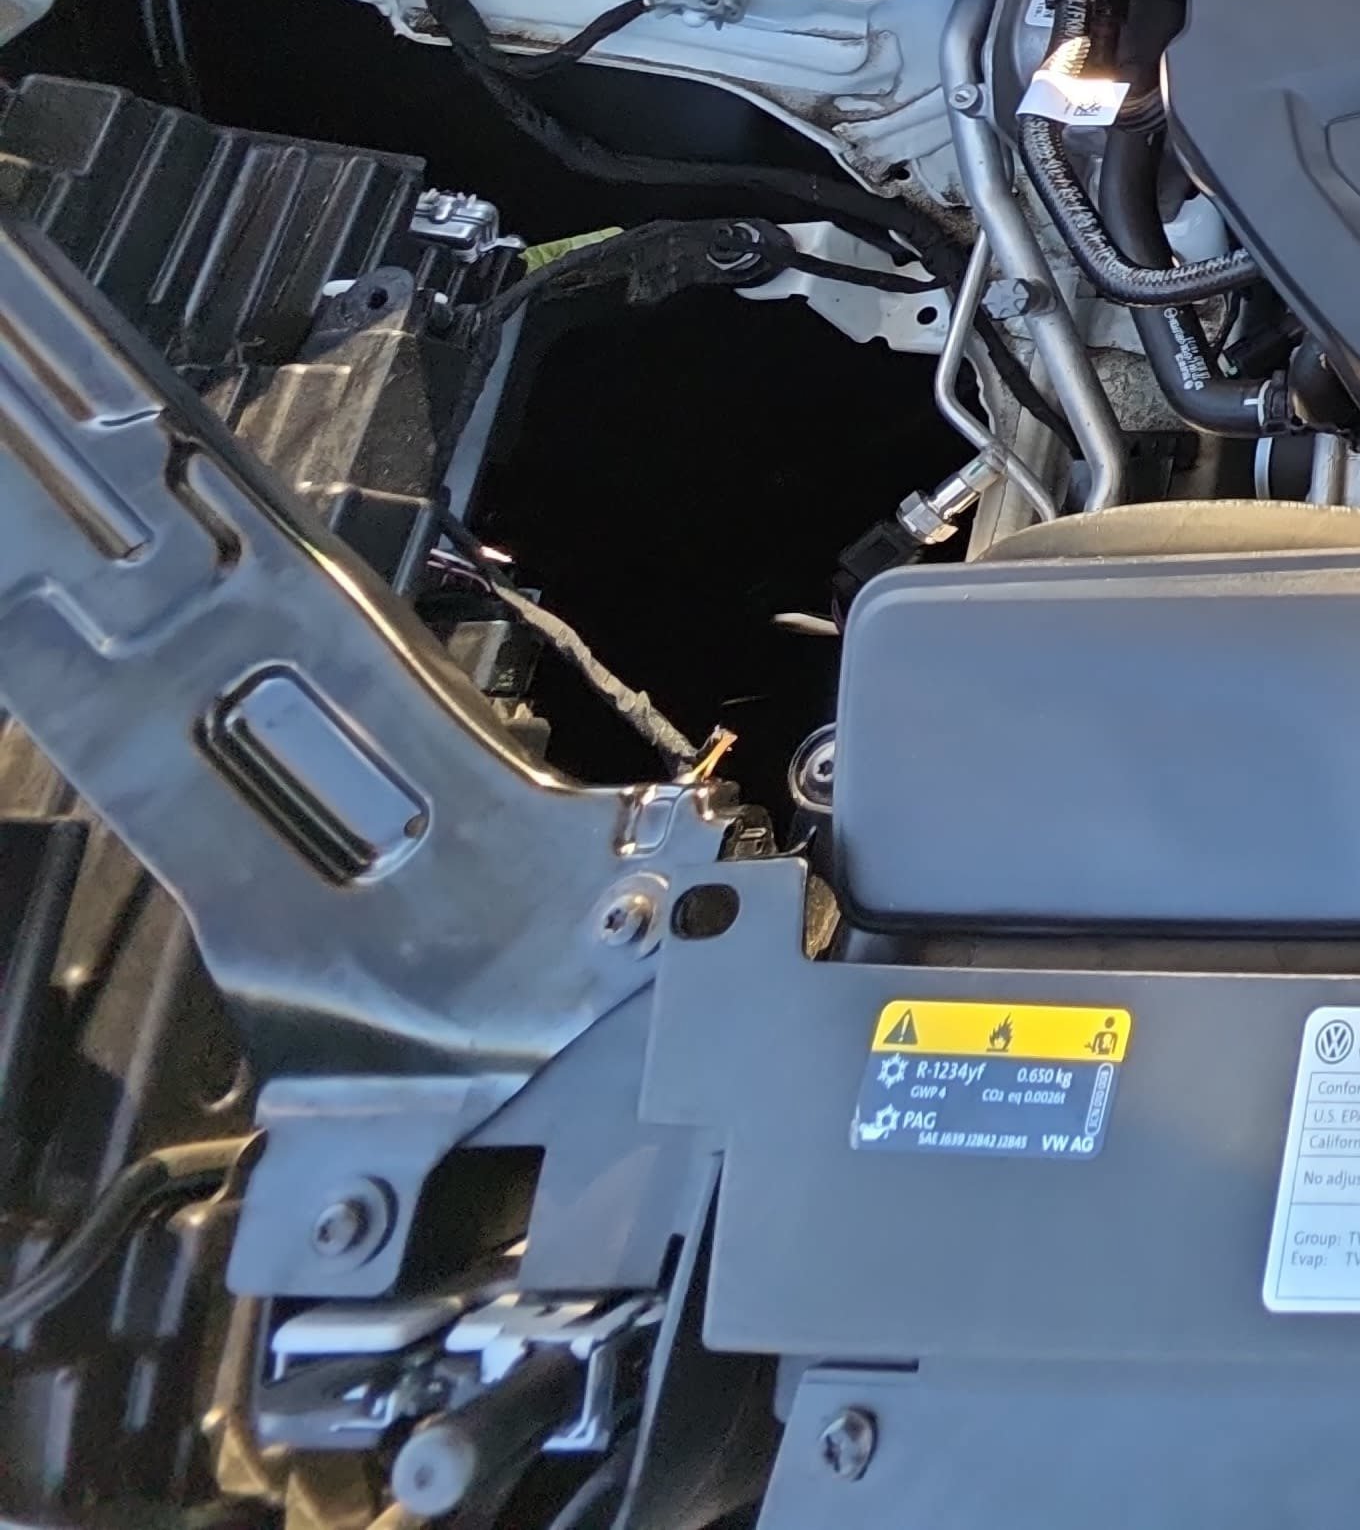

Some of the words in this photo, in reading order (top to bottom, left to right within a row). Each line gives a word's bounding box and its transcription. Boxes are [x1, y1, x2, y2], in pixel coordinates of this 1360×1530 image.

[917, 1061, 987, 1086] R-1234yf
[1017, 1068, 1054, 1083] 0.650
[1056, 1068, 1072, 1089] kg
[910, 1085, 938, 1099] GWP
[938, 1086, 947, 1099] 4
[1008, 1092, 1021, 1105] eq
[1024, 1090, 1065, 1104] 0.0026t
[903, 1110, 936, 1129] PAG
[918, 1131, 938, 1145] SAE
[1042, 1134, 1069, 1151] VW
[1070, 1136, 1094, 1152] AG
[1303, 1171, 1323, 1185] No
[1294, 1231, 1340, 1248] Group:
[1291, 1251, 1327, 1269] Evap:
